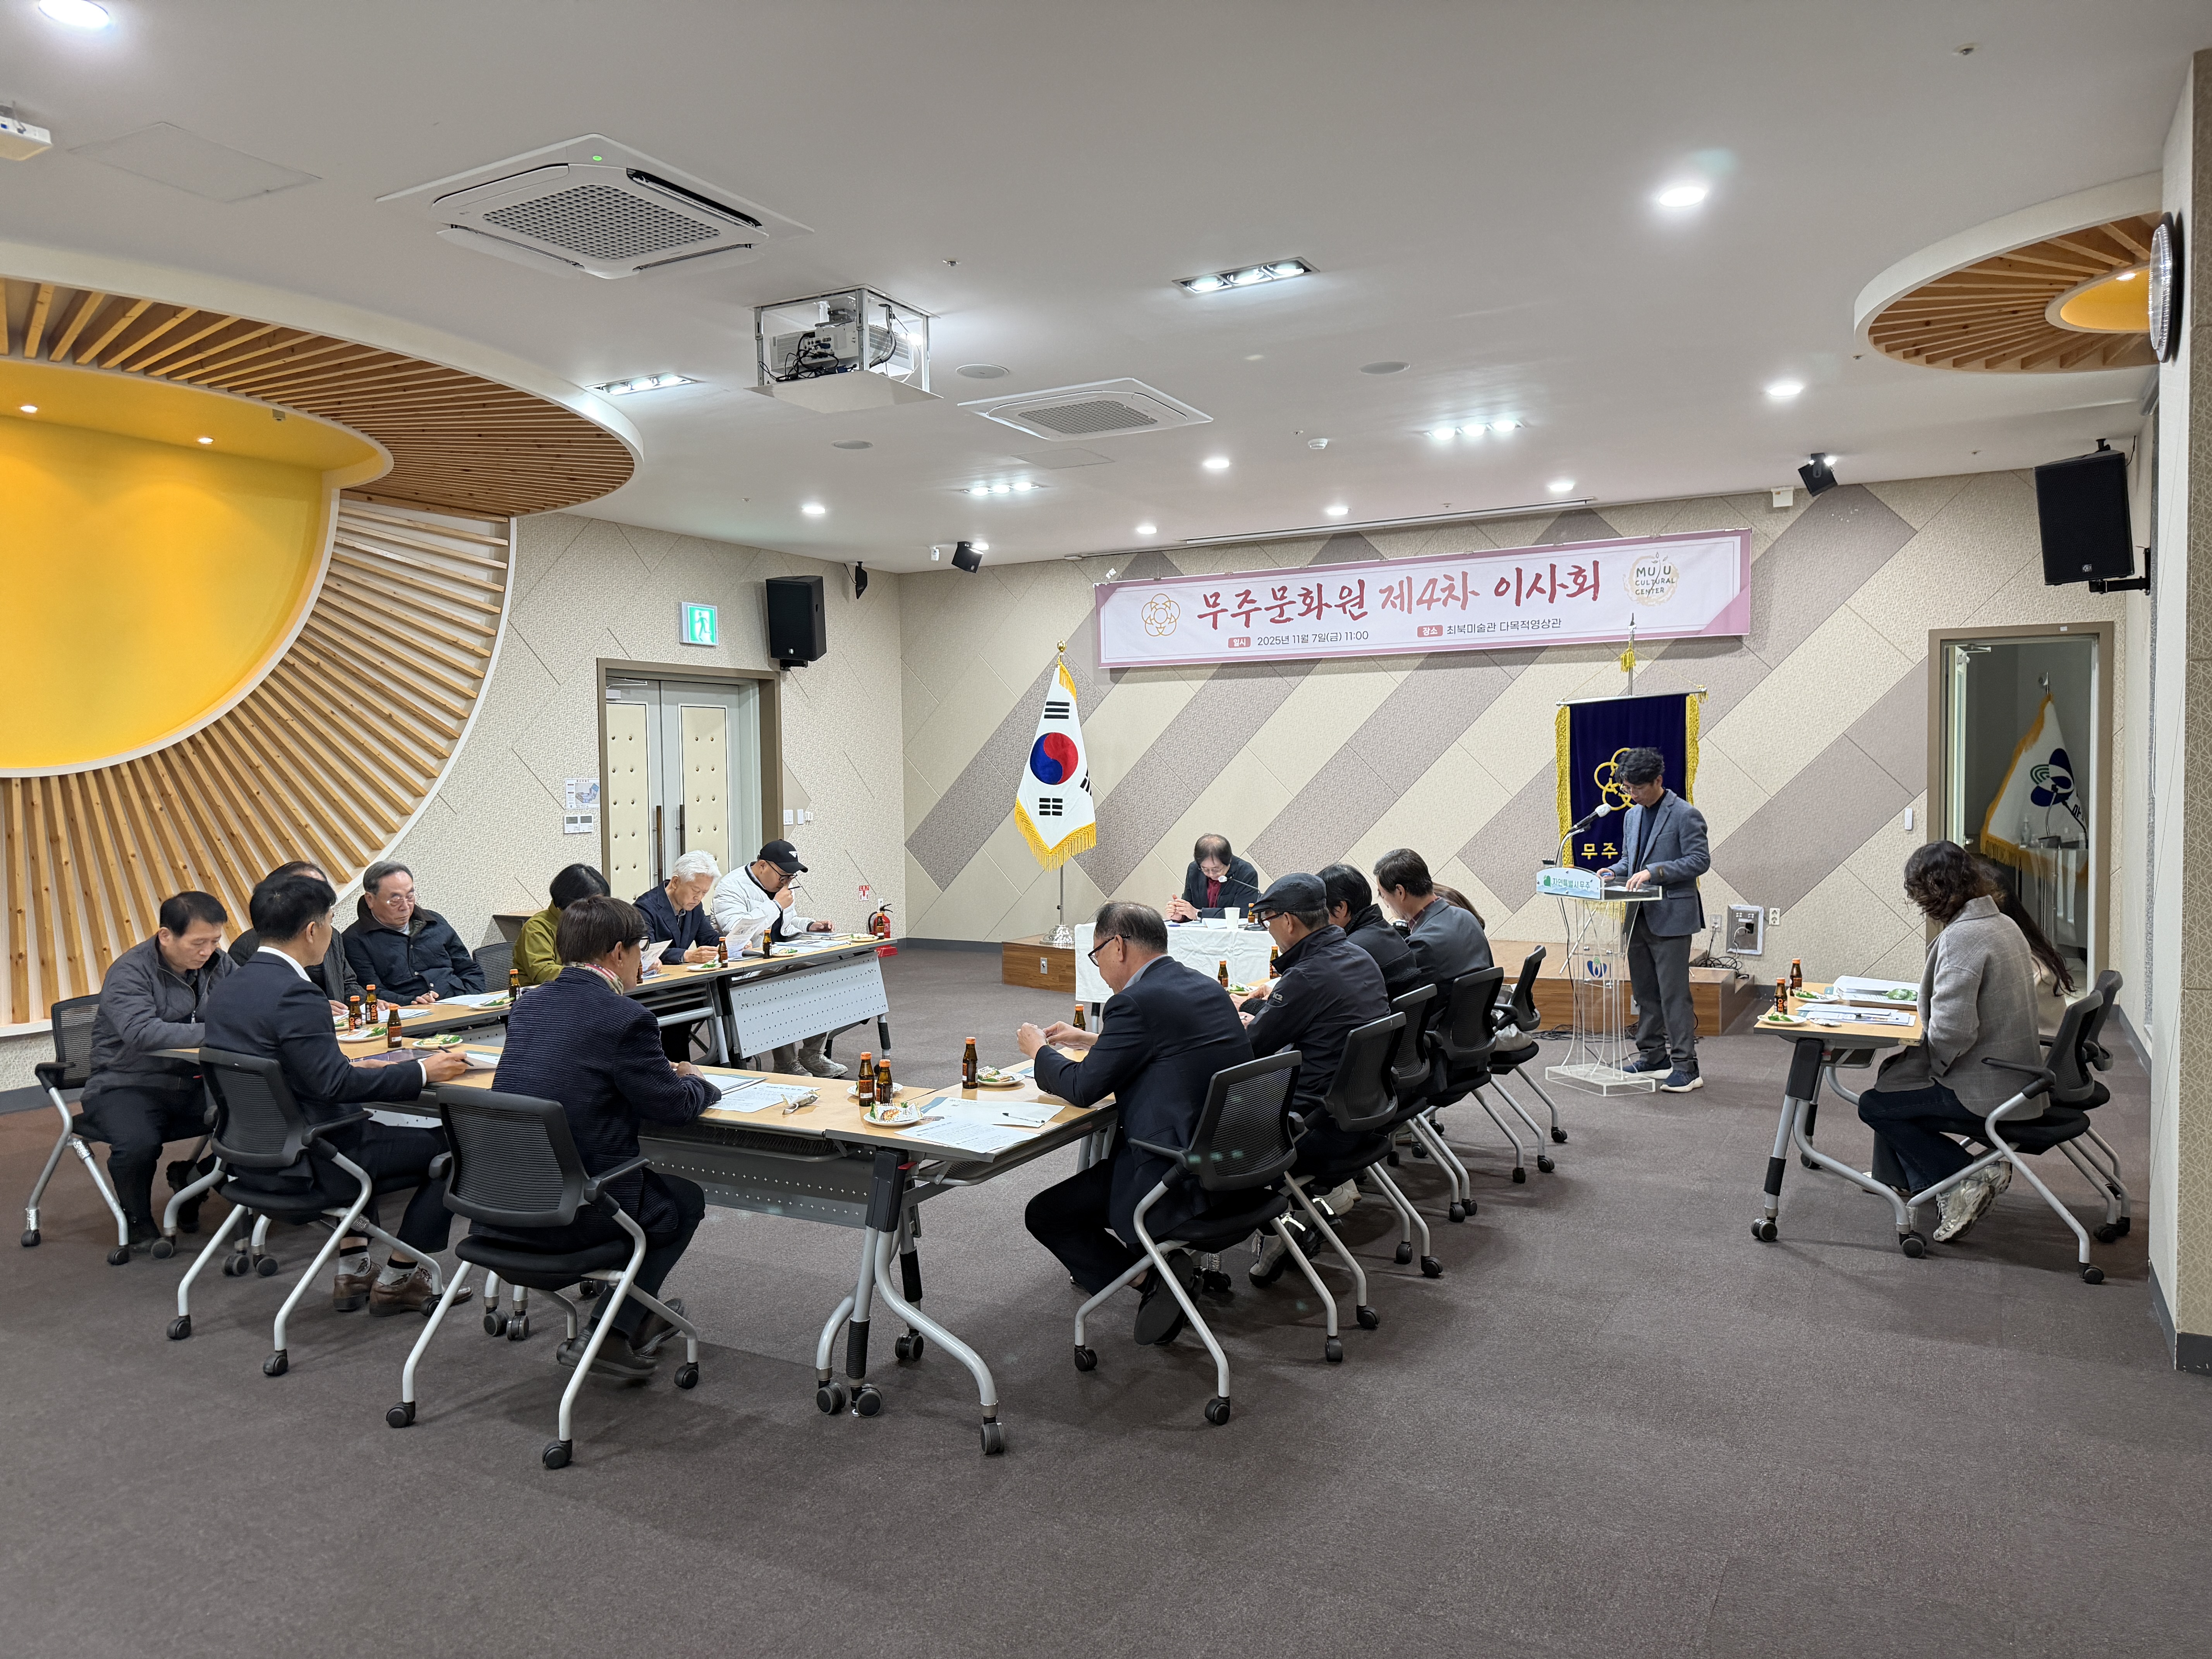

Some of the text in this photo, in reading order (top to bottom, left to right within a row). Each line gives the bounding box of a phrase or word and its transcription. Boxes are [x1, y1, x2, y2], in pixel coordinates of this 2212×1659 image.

[1635, 578, 1675, 586] CULTURAL
[1197, 560, 1599, 630] 무주문화원 제4차 이사회
[1635, 587, 1664, 595] CENTER
[1422, 618, 1562, 636] 장소 최북미술관 다목적영상관
[1233, 631, 1369, 647] 일시 2025년 11월 7일(금) 11:00
[1581, 842, 1618, 860] 무주
